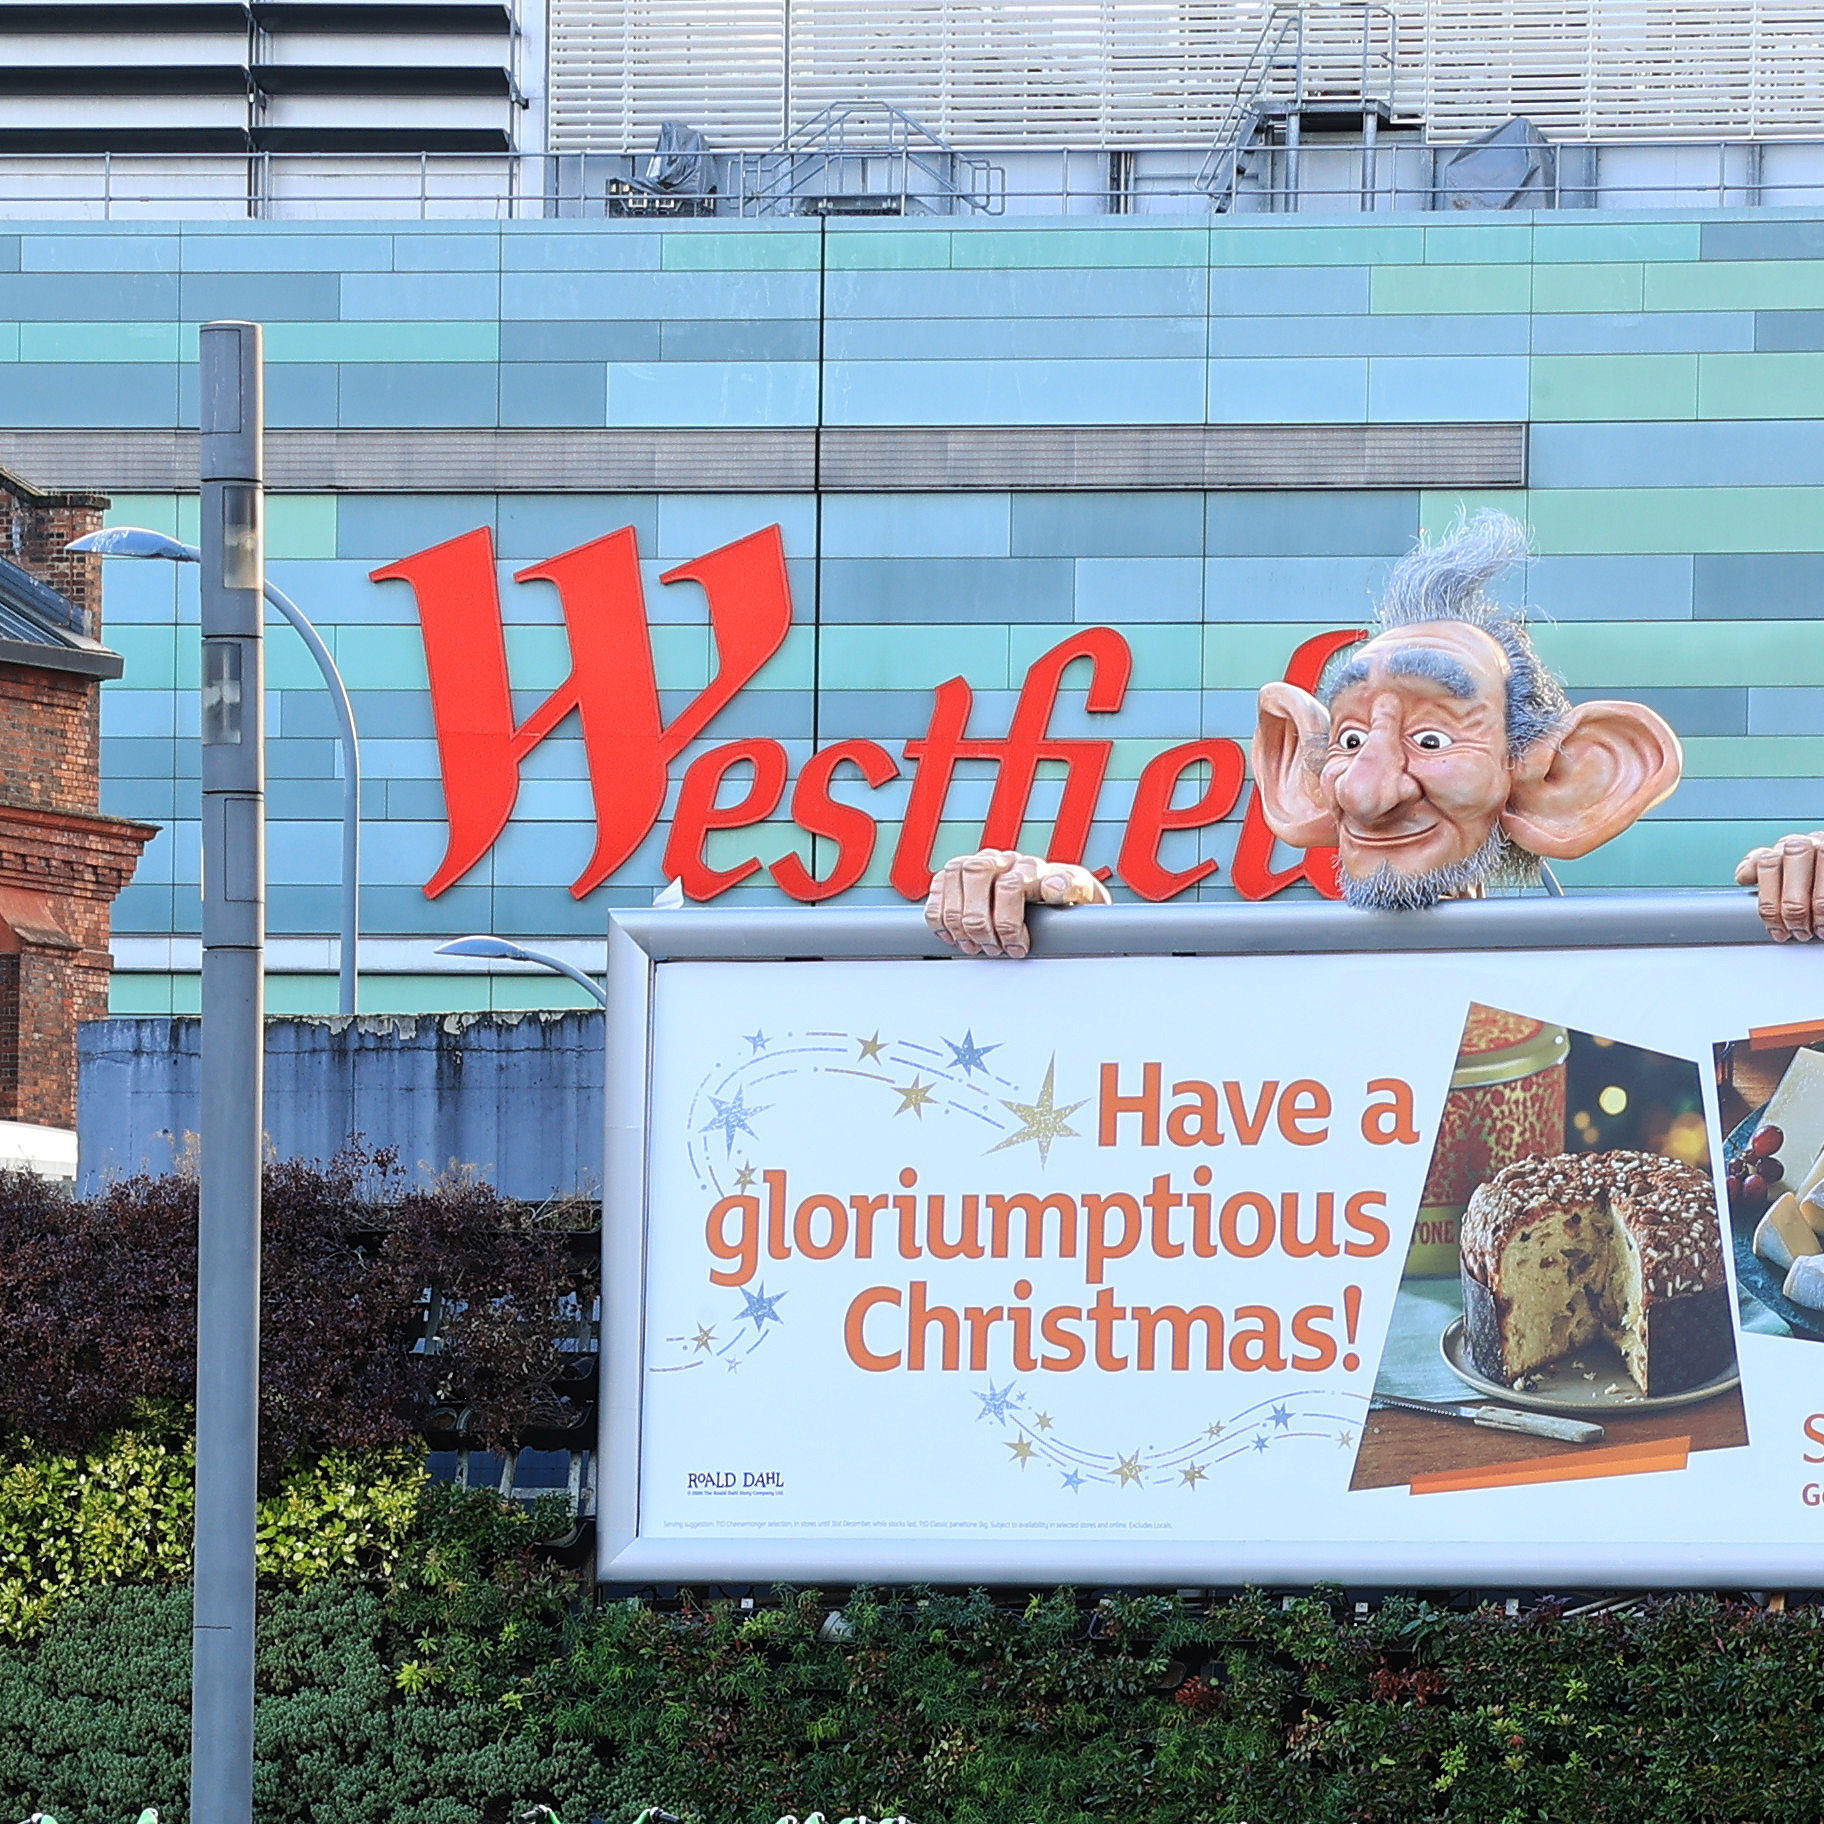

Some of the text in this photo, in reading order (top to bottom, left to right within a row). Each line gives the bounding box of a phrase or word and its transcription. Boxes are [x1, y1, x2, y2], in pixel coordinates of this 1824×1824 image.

[371, 524, 1370, 900] Westfiel
[1098, 1062, 1419, 1146] Have a
[706, 1166, 1390, 1287] gloriumptious
[844, 1280, 1362, 1372] Christmas!
[687, 1471, 784, 1489] ROALD DAHL
